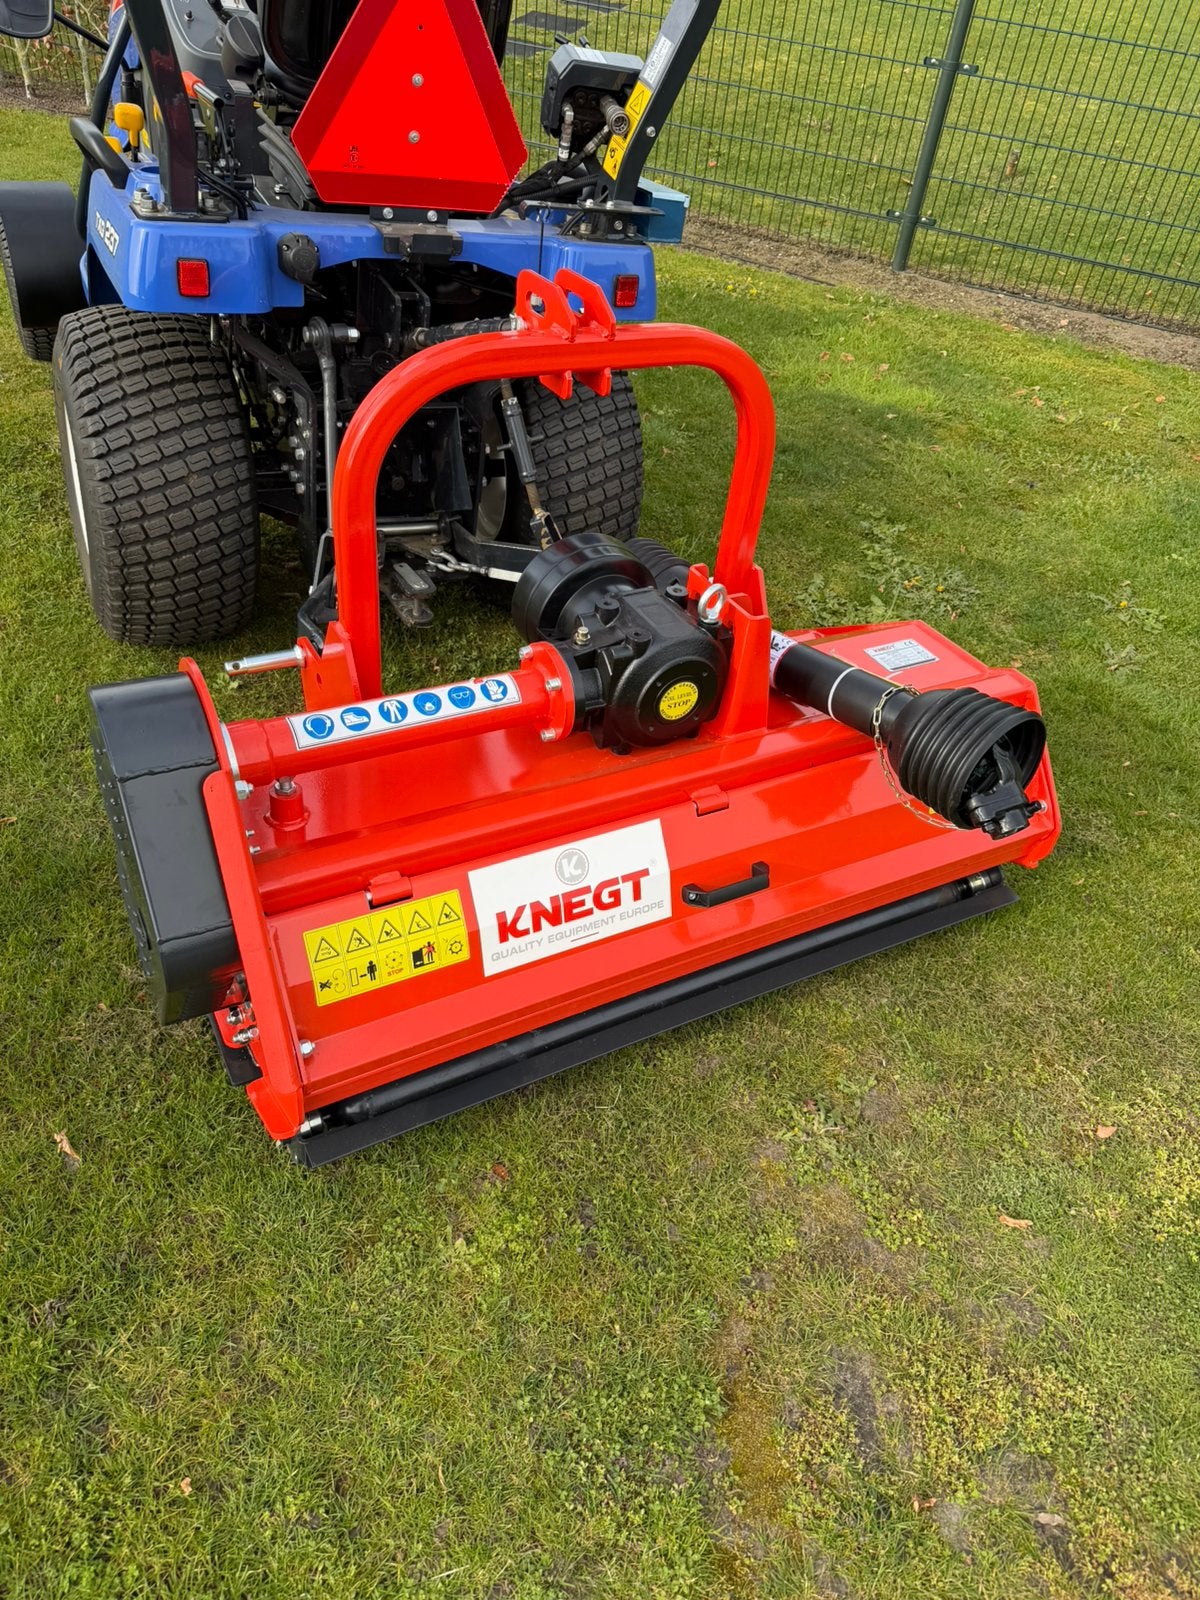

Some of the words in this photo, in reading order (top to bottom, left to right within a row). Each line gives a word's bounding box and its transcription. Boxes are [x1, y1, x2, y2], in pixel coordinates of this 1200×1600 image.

[667, 699, 691, 710] STOP
[495, 867, 651, 944] KNEGT
[491, 937, 544, 962] QUALITY
[547, 914, 617, 944] EQUIPMENT
[619, 899, 665, 921] EUROPE
[387, 967, 404, 977] STOP
